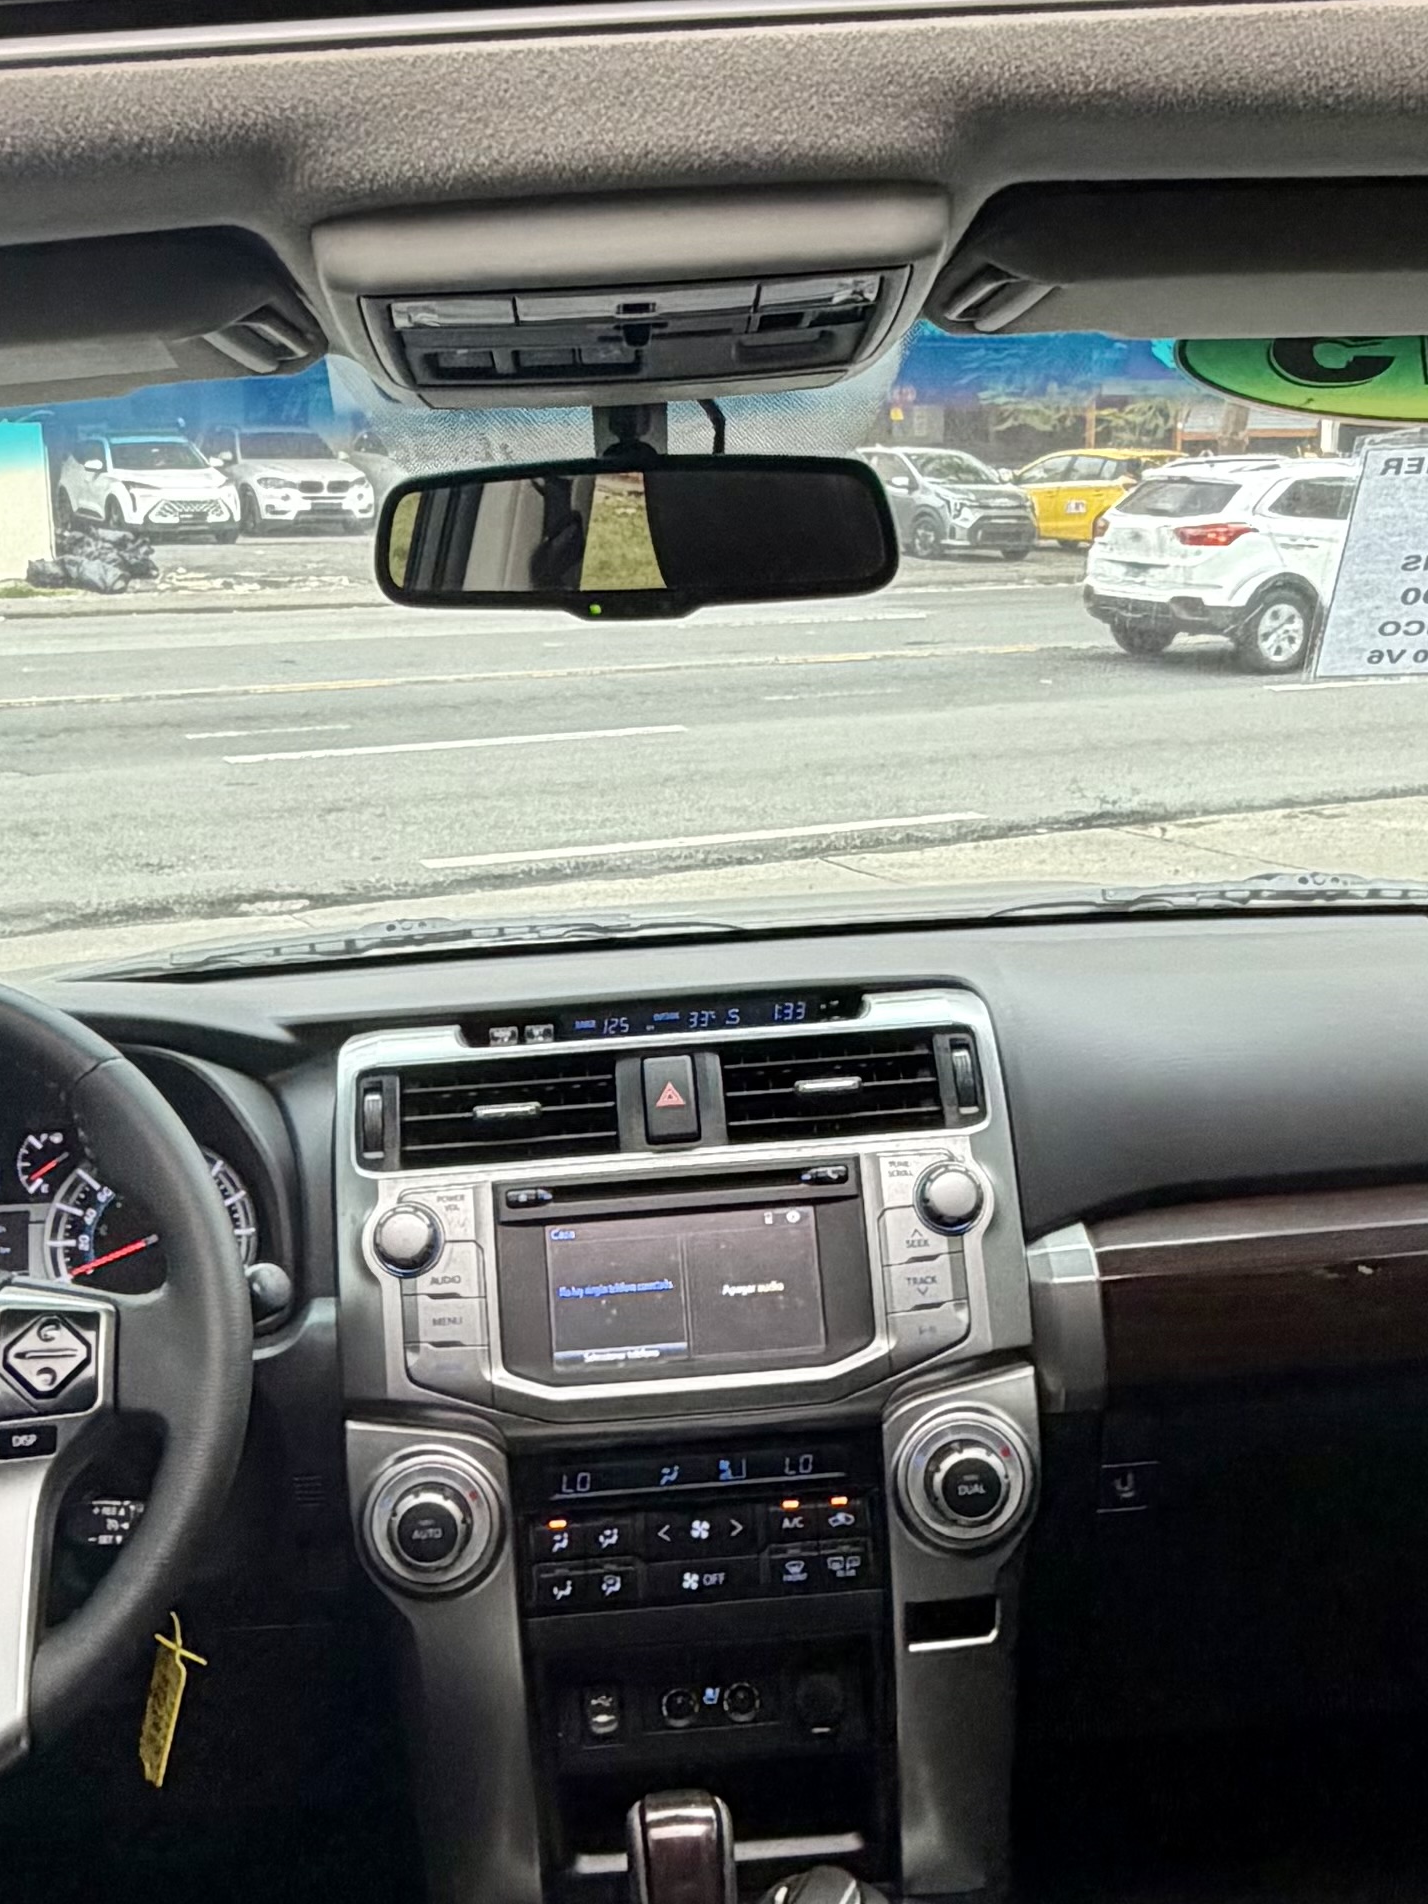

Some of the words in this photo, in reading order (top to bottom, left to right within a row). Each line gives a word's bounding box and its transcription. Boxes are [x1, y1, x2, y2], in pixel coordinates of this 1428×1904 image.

[601, 1017, 630, 1034] 125
[905, 1238, 931, 1248] SEEK
[430, 1275, 462, 1286] AUDIO
[906, 1276, 938, 1286] TRACK
[432, 1316, 464, 1327] MENU
[784, 1454, 814, 1476] LO
[561, 1472, 592, 1493] LO
[782, 1516, 804, 1529] A/C
[412, 1527, 443, 1540] AUTO
[703, 1572, 726, 1586] OFF
